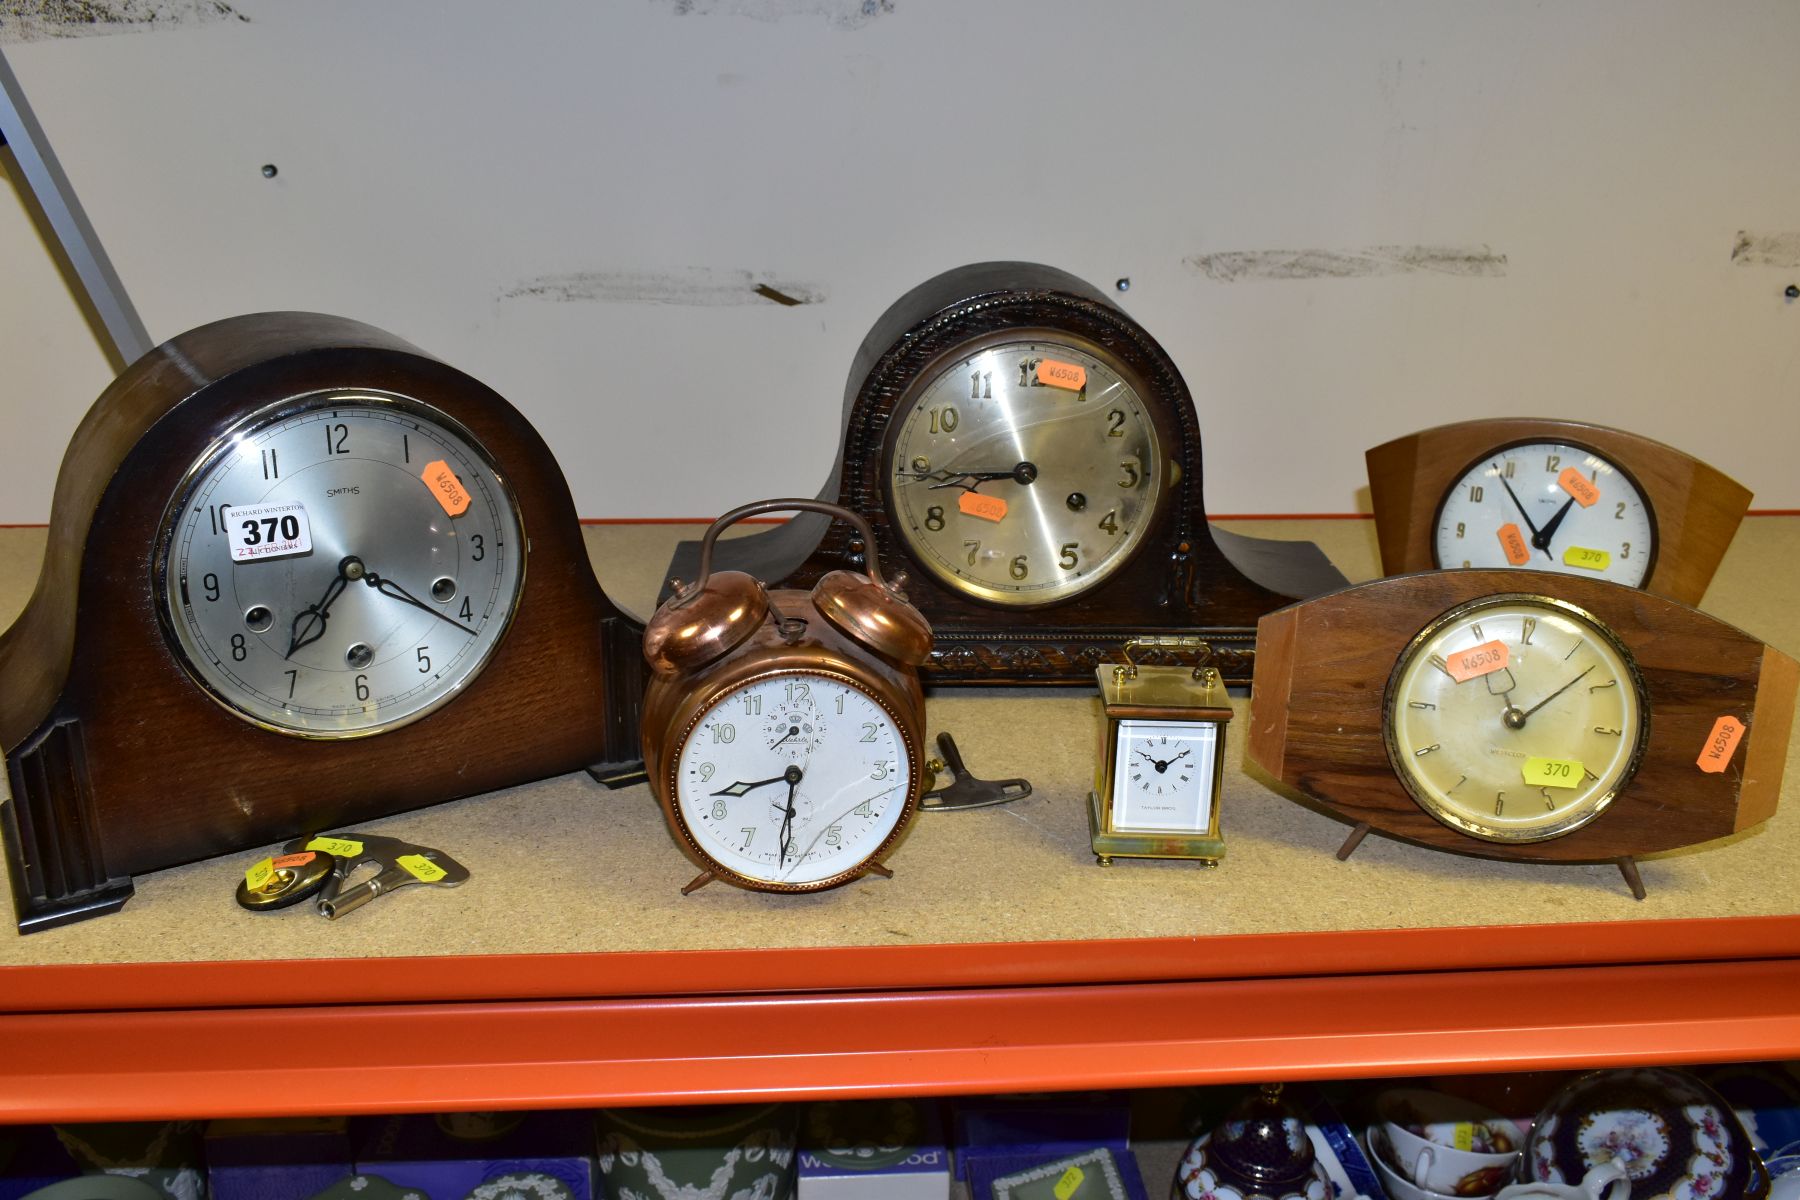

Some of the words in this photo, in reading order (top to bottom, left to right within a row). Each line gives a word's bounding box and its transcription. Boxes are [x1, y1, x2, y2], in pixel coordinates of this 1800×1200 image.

[970, 370, 993, 399] 11
[1049, 366, 1080, 382] W6508
[929, 406, 959, 435] 10
[1106, 408, 1126, 437] 2
[326, 424, 350, 456] 12
[403, 434, 409, 464] 1
[261, 448, 279, 480] 11
[1117, 460, 1139, 488] 3
[1505, 462, 1516, 479] 11
[1545, 455, 1561, 473] 12
[327, 484, 360, 498] SMITHS
[436, 471, 463, 506] W6508
[1469, 486, 1484, 503] 10
[231, 508, 263, 518] RICHARD
[924, 504, 946, 532] 8
[1615, 502, 1626, 520] 2
[242, 515, 300, 546] 370
[1098, 510, 1119, 536] 4
[1456, 522, 1466, 539] 9
[470, 534, 485, 562] 3
[963, 539, 981, 567] 7
[1058, 542, 1079, 571] 5
[1581, 550, 1602, 563] 370
[1620, 542, 1631, 560] 3
[1008, 554, 1029, 581] 6
[203, 572, 221, 602] 9
[459, 596, 474, 623] 4
[230, 632, 247, 662] 8
[416, 646, 432, 673] 5
[1461, 649, 1502, 672] W6508
[284, 669, 298, 699] 7
[354, 674, 371, 702] 6
[784, 683, 810, 704] 12
[743, 695, 763, 716] 11
[835, 694, 845, 715] 1
[710, 723, 736, 745] 10
[859, 722, 878, 743] 2
[1709, 724, 1735, 760] W6508
[699, 762, 716, 783] 9
[870, 760, 889, 780] 3
[1543, 763, 1571, 778] 370
[711, 799, 728, 820] 8
[853, 798, 873, 819] 4
[1495, 791, 1506, 817] 6
[740, 827, 757, 848] 7
[825, 825, 843, 846] 5
[326, 841, 353, 853] 370
[413, 862, 436, 876] 370
